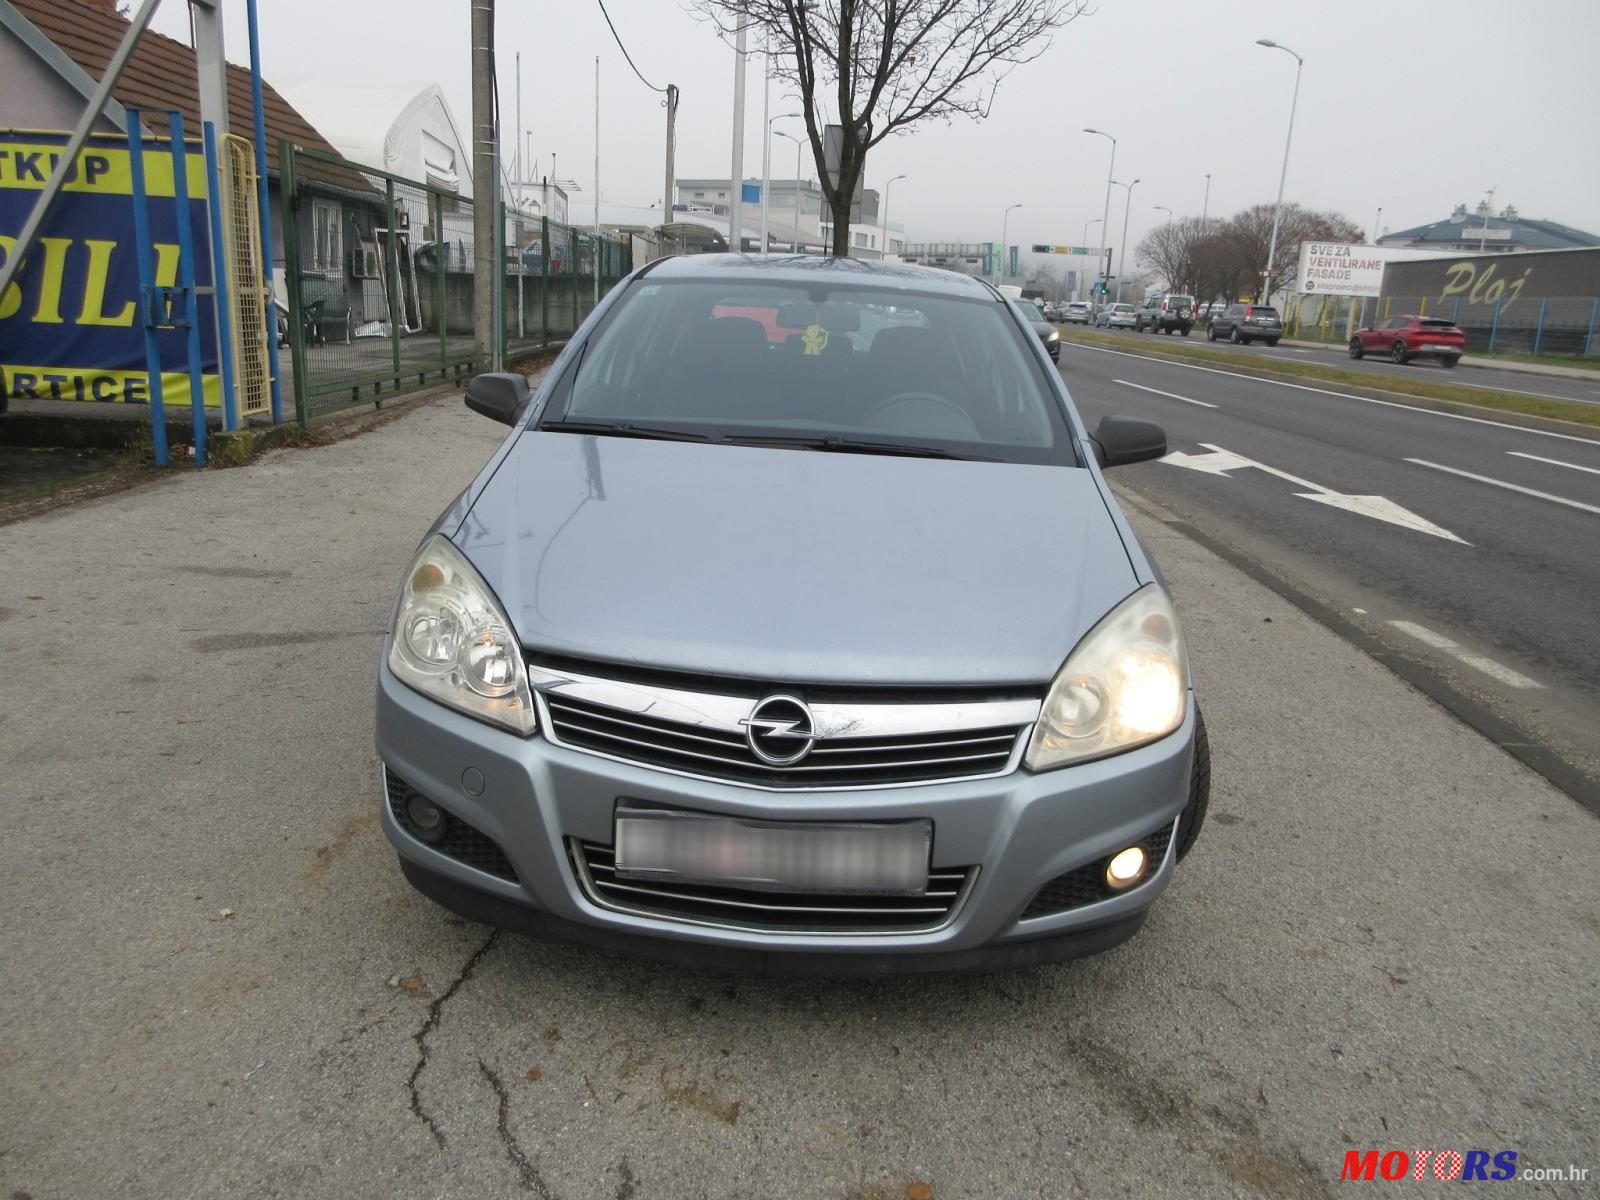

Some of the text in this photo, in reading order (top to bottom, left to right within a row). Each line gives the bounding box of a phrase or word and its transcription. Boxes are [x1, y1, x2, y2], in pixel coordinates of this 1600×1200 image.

[0, 151, 110, 185] KUP
[1310, 244, 1351, 257] SVE ZA
[1309, 257, 1382, 270] VENTILIRANE
[1307, 268, 1351, 280] FASADE
